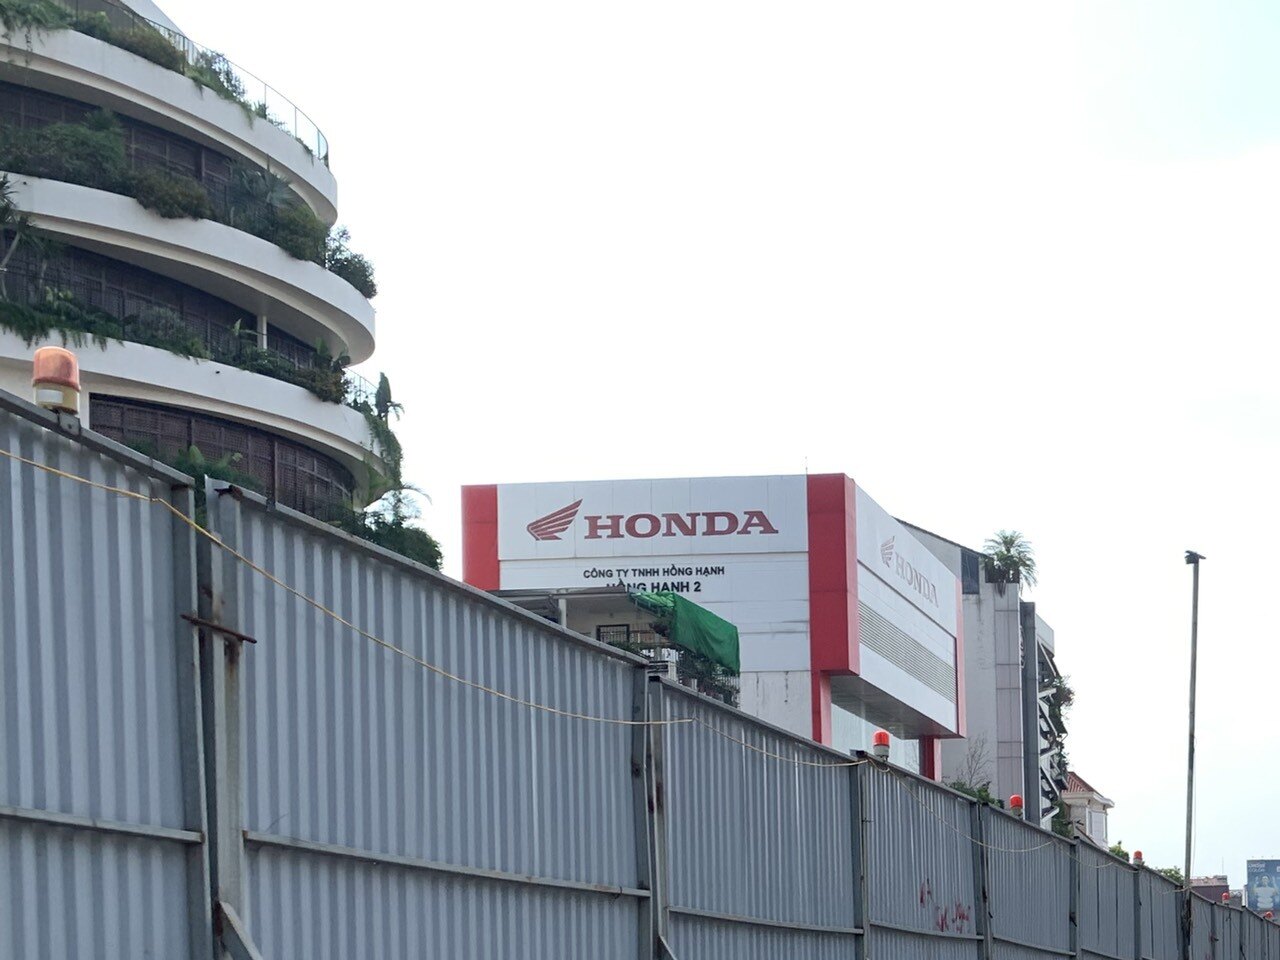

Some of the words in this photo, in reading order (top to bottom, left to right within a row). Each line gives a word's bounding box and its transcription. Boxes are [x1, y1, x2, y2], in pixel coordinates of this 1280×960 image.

[584, 510, 779, 539] HONDA
[583, 567, 614, 579] CÔNG
[616, 568, 629, 578] TY
[631, 568, 660, 578] TNHH
[662, 564, 693, 577] HỒNG
[695, 566, 725, 577] HẠNH
[895, 551, 939, 608] HONDA
[693, 581, 702, 592] 2
